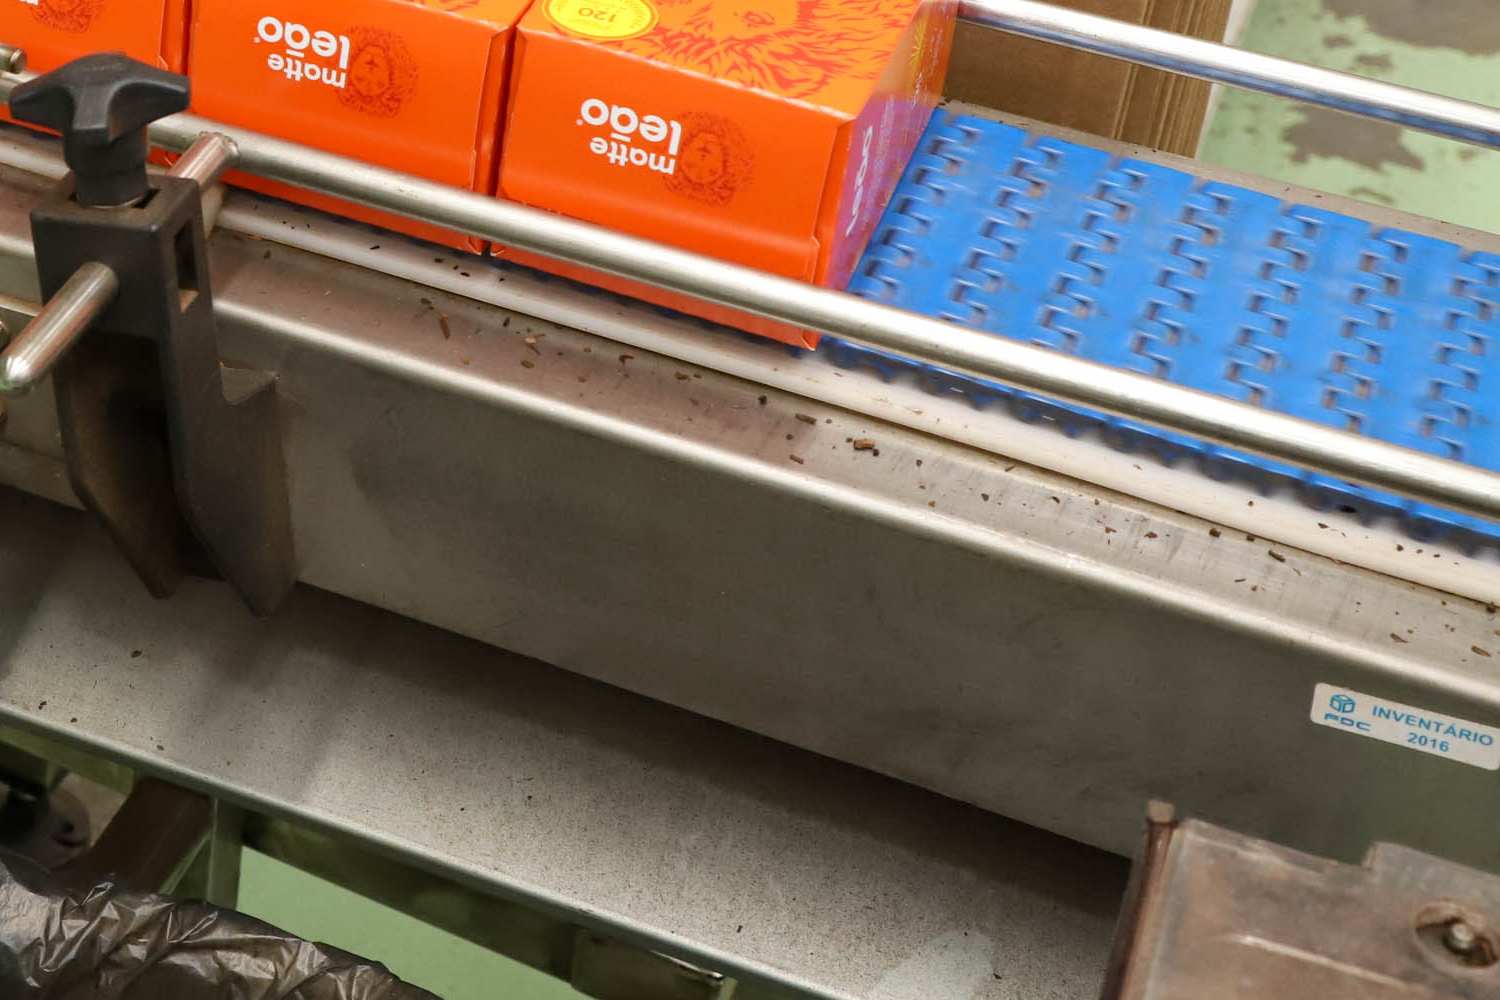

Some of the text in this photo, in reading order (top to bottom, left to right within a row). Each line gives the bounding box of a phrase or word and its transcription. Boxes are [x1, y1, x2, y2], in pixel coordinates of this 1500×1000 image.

[257, 16, 350, 69] leão
[268, 53, 347, 88] matte
[581, 98, 681, 155] leão
[590, 136, 677, 175] matte
[1372, 705, 1494, 746] INVENTÁRIO
[1407, 732, 1451, 753] 2016
